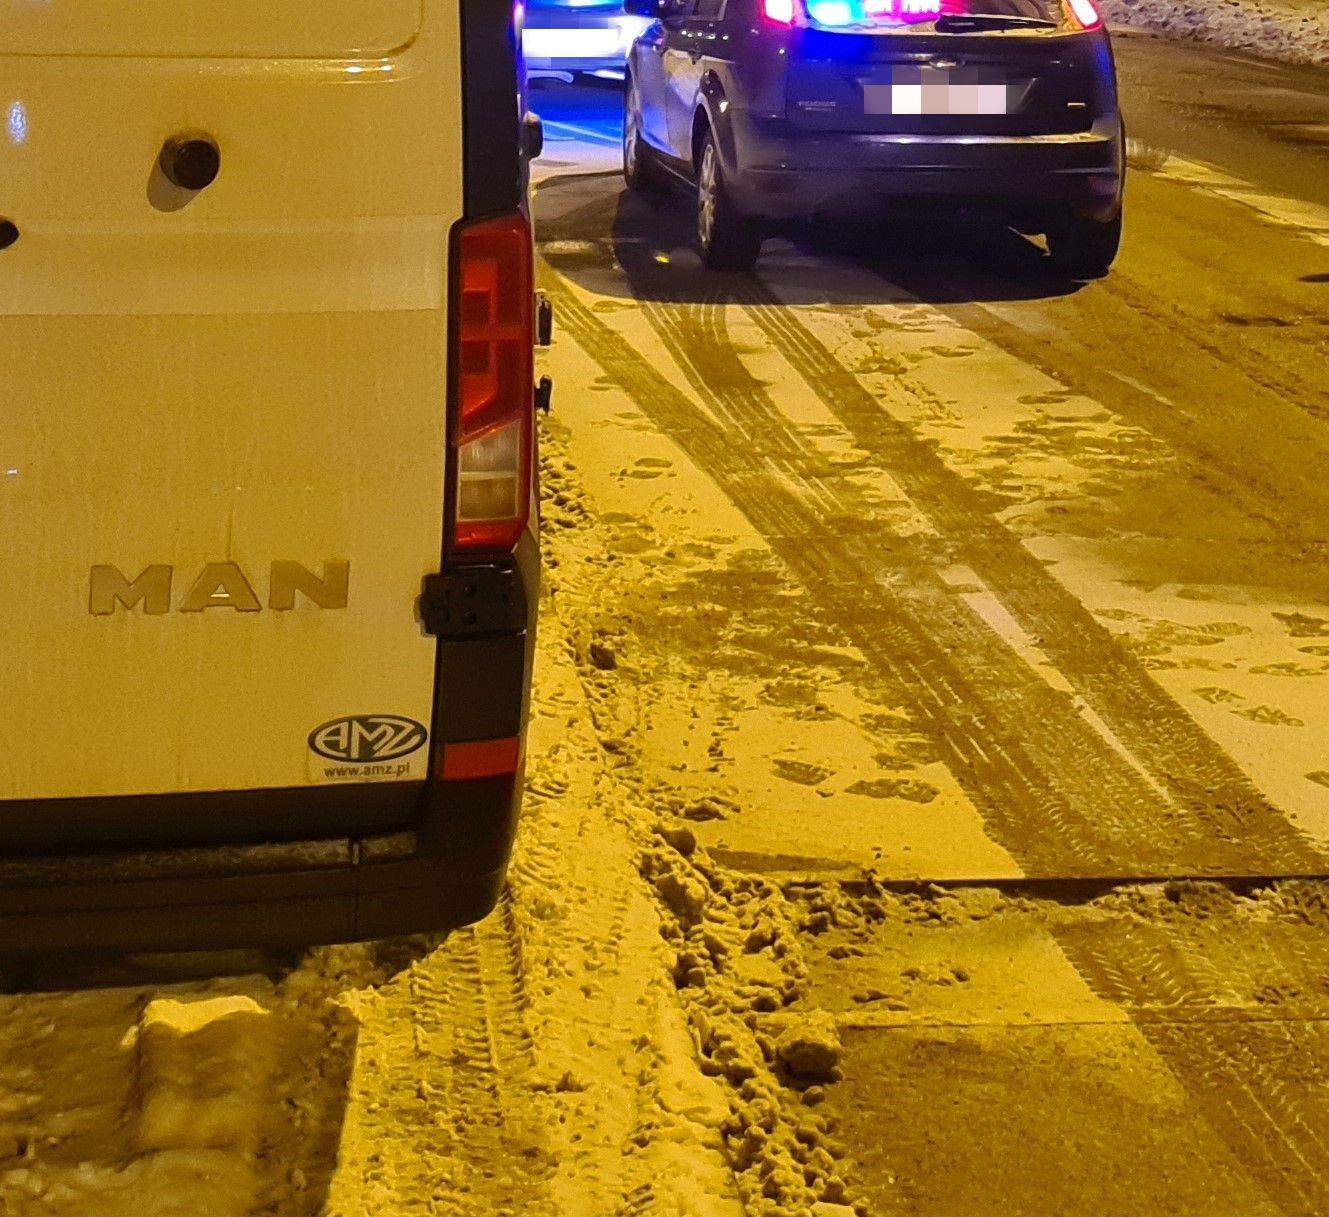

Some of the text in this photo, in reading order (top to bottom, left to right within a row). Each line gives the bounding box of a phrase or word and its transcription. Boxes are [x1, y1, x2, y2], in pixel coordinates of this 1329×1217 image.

[88, 560, 350, 616] MAN
[313, 716, 423, 760] AMZ
[323, 762, 411, 777] www.amz.pl
